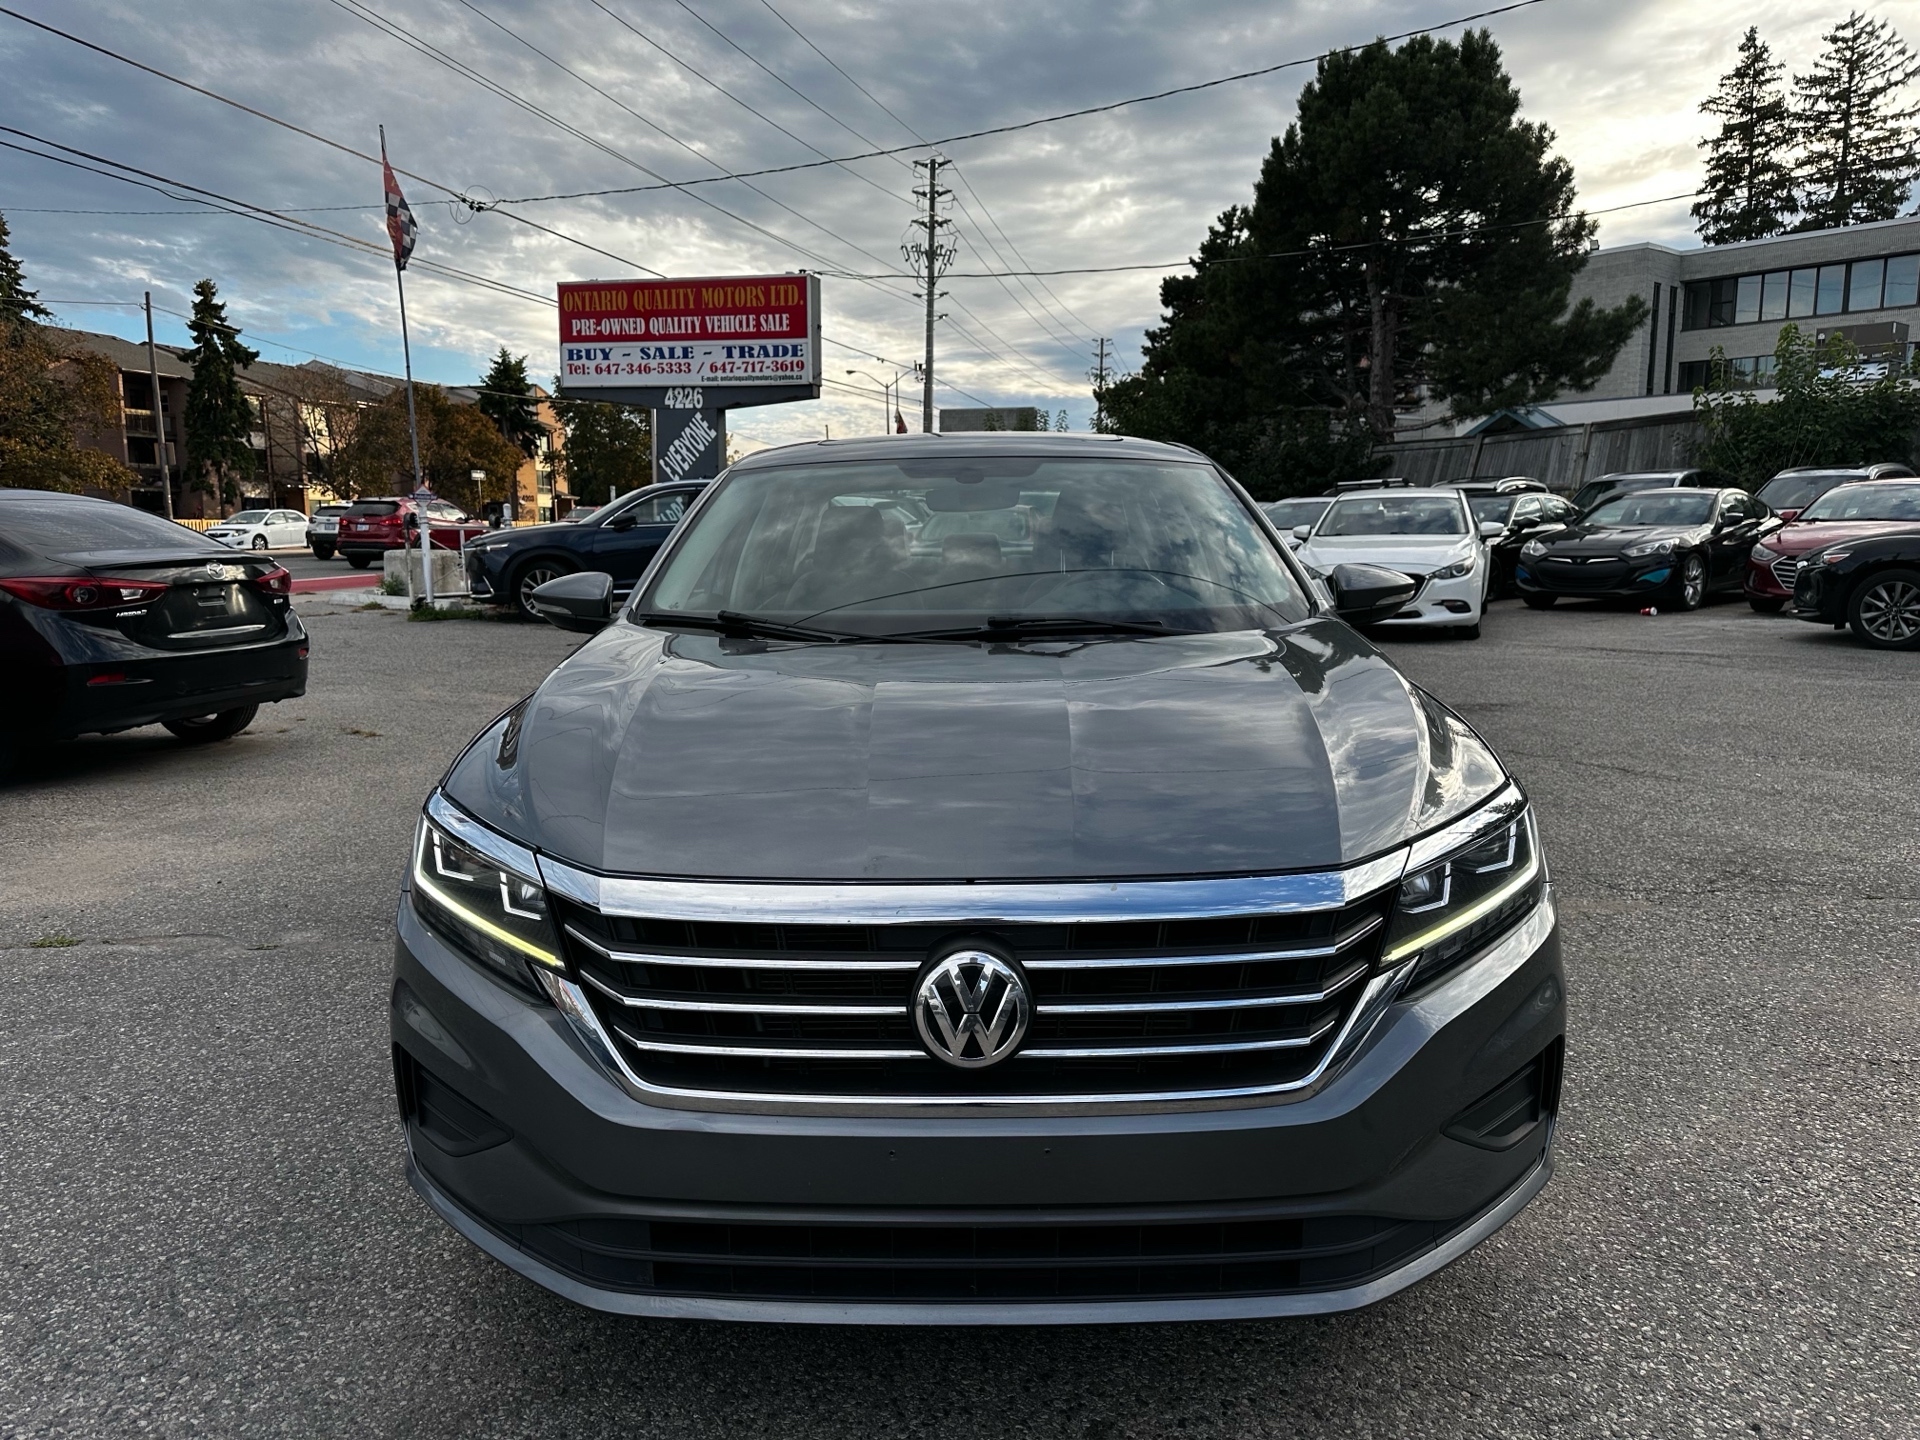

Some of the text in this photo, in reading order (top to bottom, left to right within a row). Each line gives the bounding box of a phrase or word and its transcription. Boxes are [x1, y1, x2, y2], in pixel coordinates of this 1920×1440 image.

[563, 284, 804, 313] ONTARIO QUALITY MOTORS LTD.
[571, 313, 790, 336] PRE-OWNED QUALITY VEHICLE SALE
[566, 347, 614, 361] BUY
[639, 346, 695, 360] SALE
[721, 344, 804, 359] TRADE
[566, 359, 805, 375] Tel: 647-346-5333 / 647-717-3619
[664, 387, 704, 409] 4226
[659, 411, 717, 481] EVERYONE
